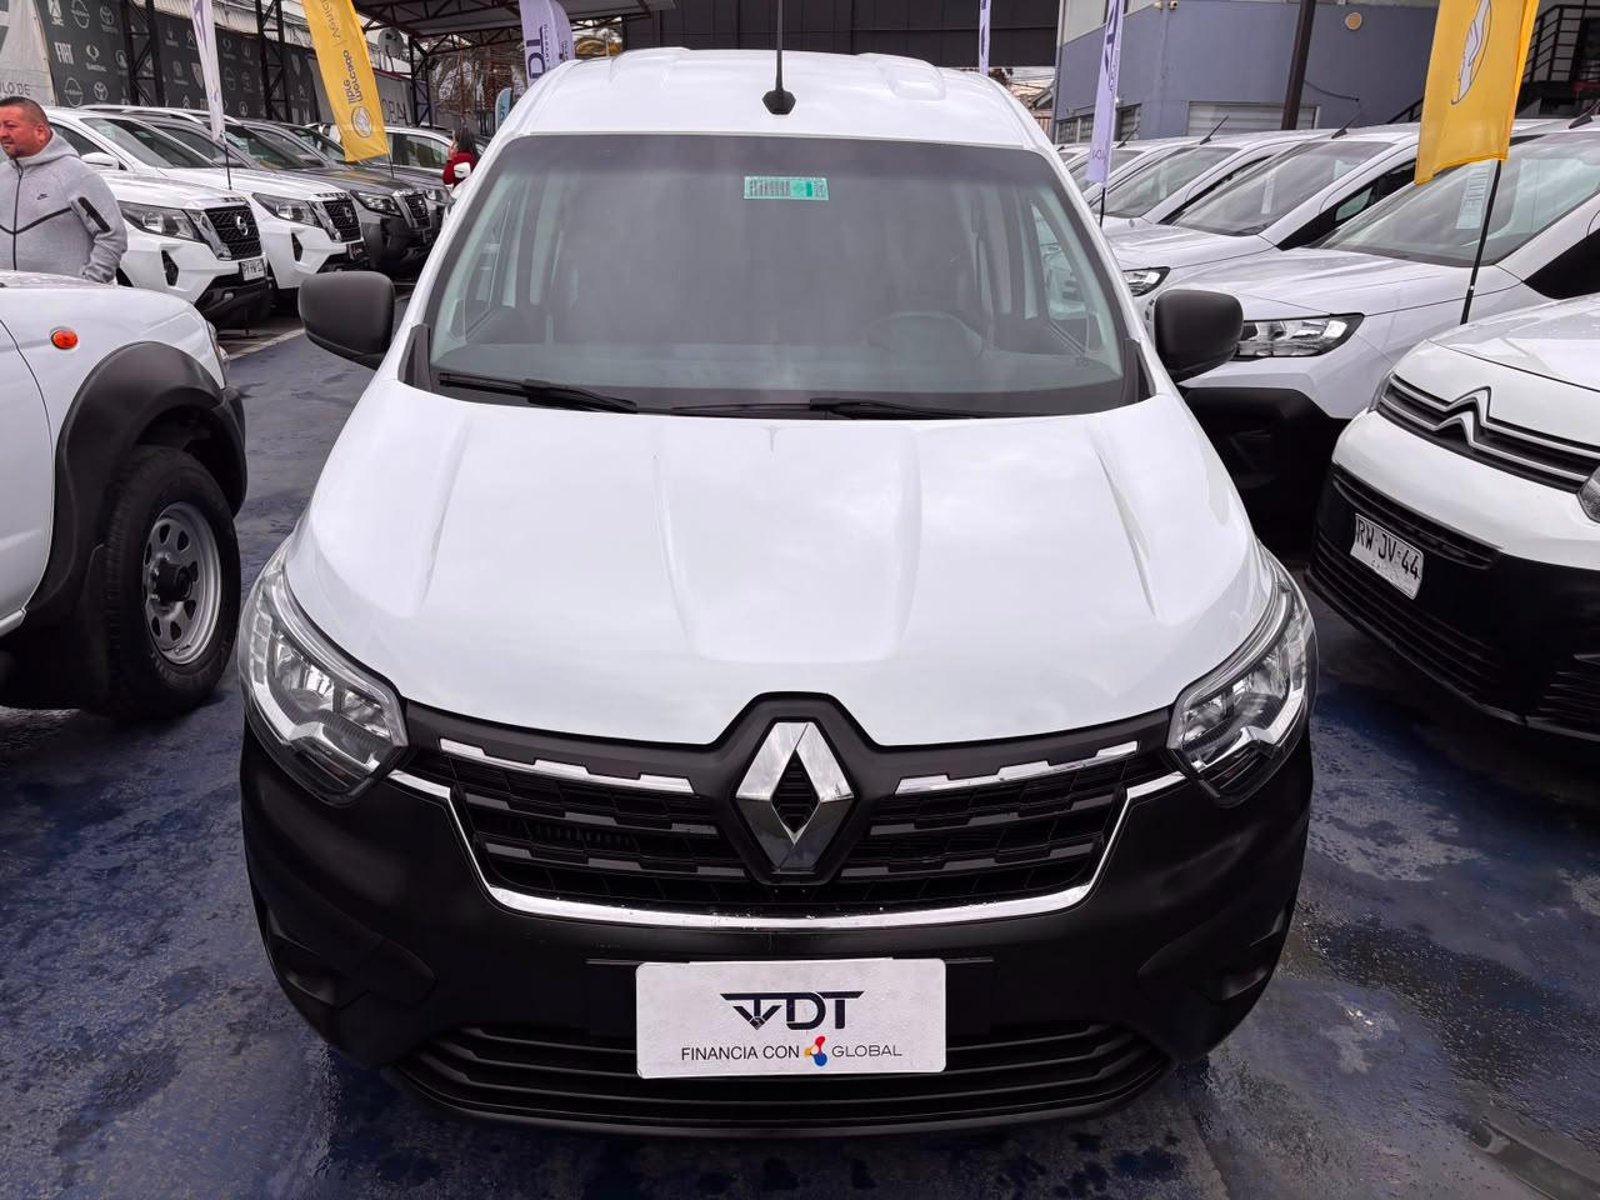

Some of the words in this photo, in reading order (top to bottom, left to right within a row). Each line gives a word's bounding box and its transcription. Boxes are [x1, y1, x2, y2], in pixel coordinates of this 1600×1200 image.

[1401, 549, 1419, 580] 44
[681, 1047, 759, 1061] FINANCIA
[762, 1045, 800, 1060] CON
[831, 1044, 903, 1057] GLOBAL
